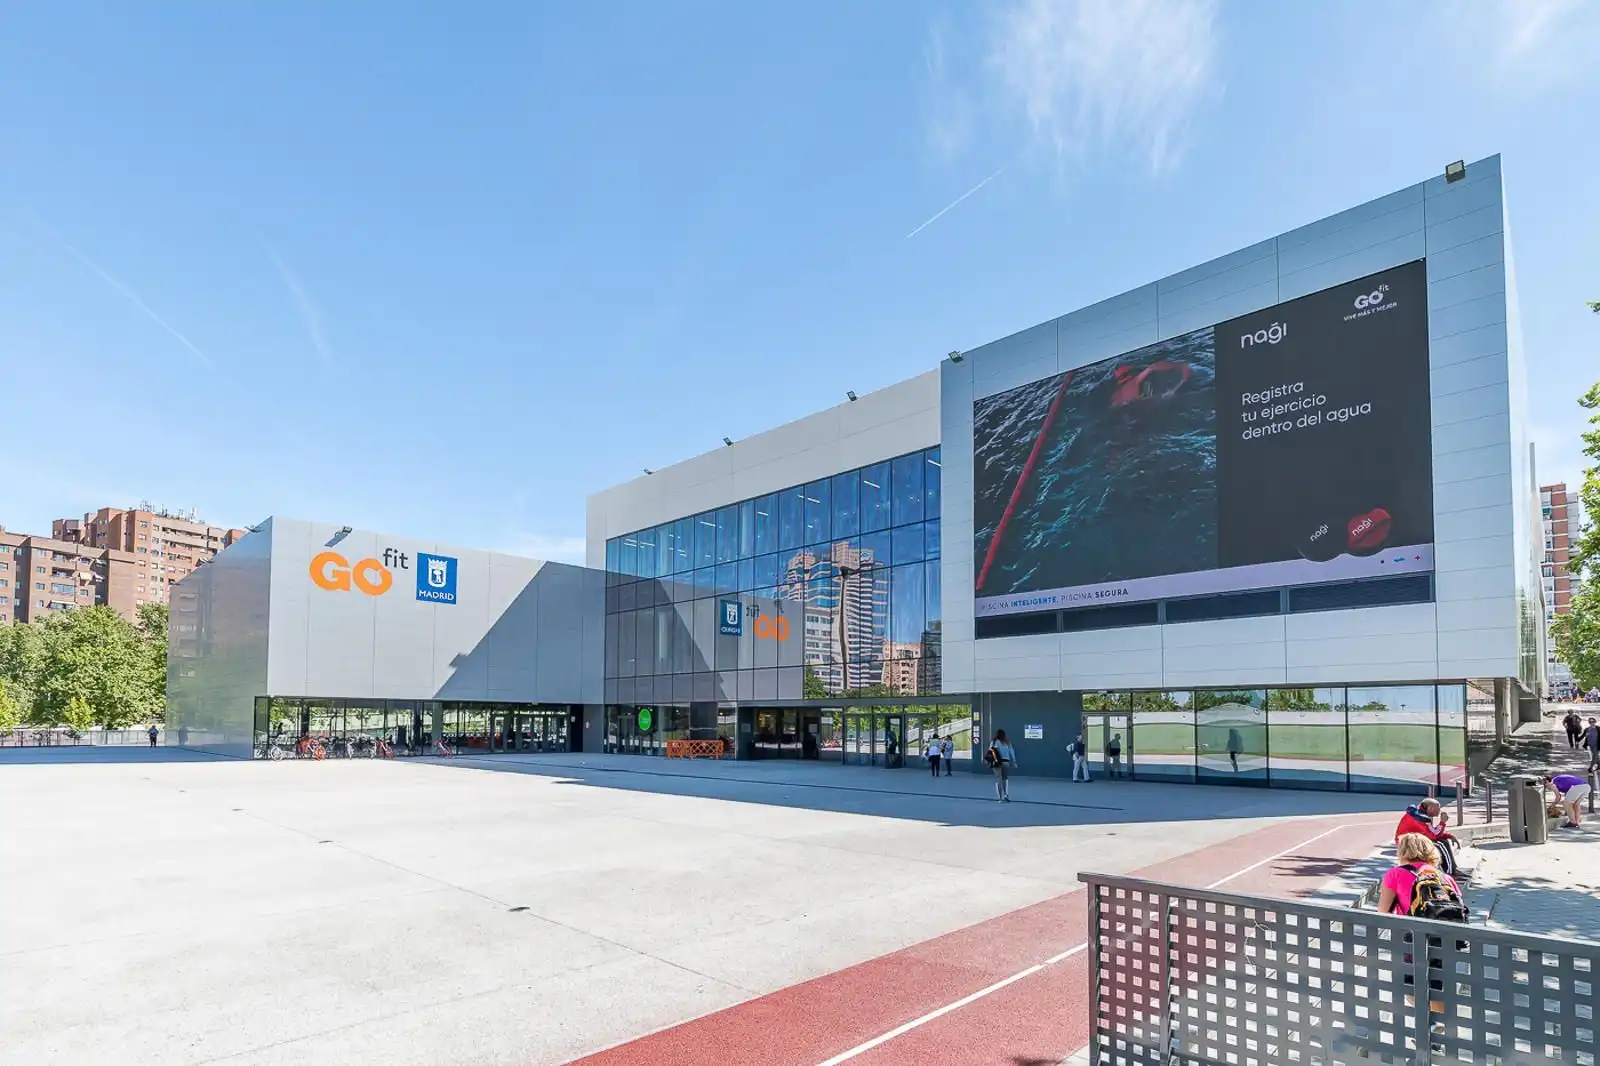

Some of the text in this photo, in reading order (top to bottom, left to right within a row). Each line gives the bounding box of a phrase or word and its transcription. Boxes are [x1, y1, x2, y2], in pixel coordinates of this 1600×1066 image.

[1354, 290, 1384, 309] GO
[1241, 382, 1304, 406] Registra
[1241, 394, 1327, 423] tu ejercicio
[1242, 402, 1372, 440] dentro del agua
[309, 548, 409, 596] GO fit
[418, 590, 455, 601] MADRID
[1061, 593, 1092, 602] PISCINA
[1095, 588, 1128, 598] SEGURA
